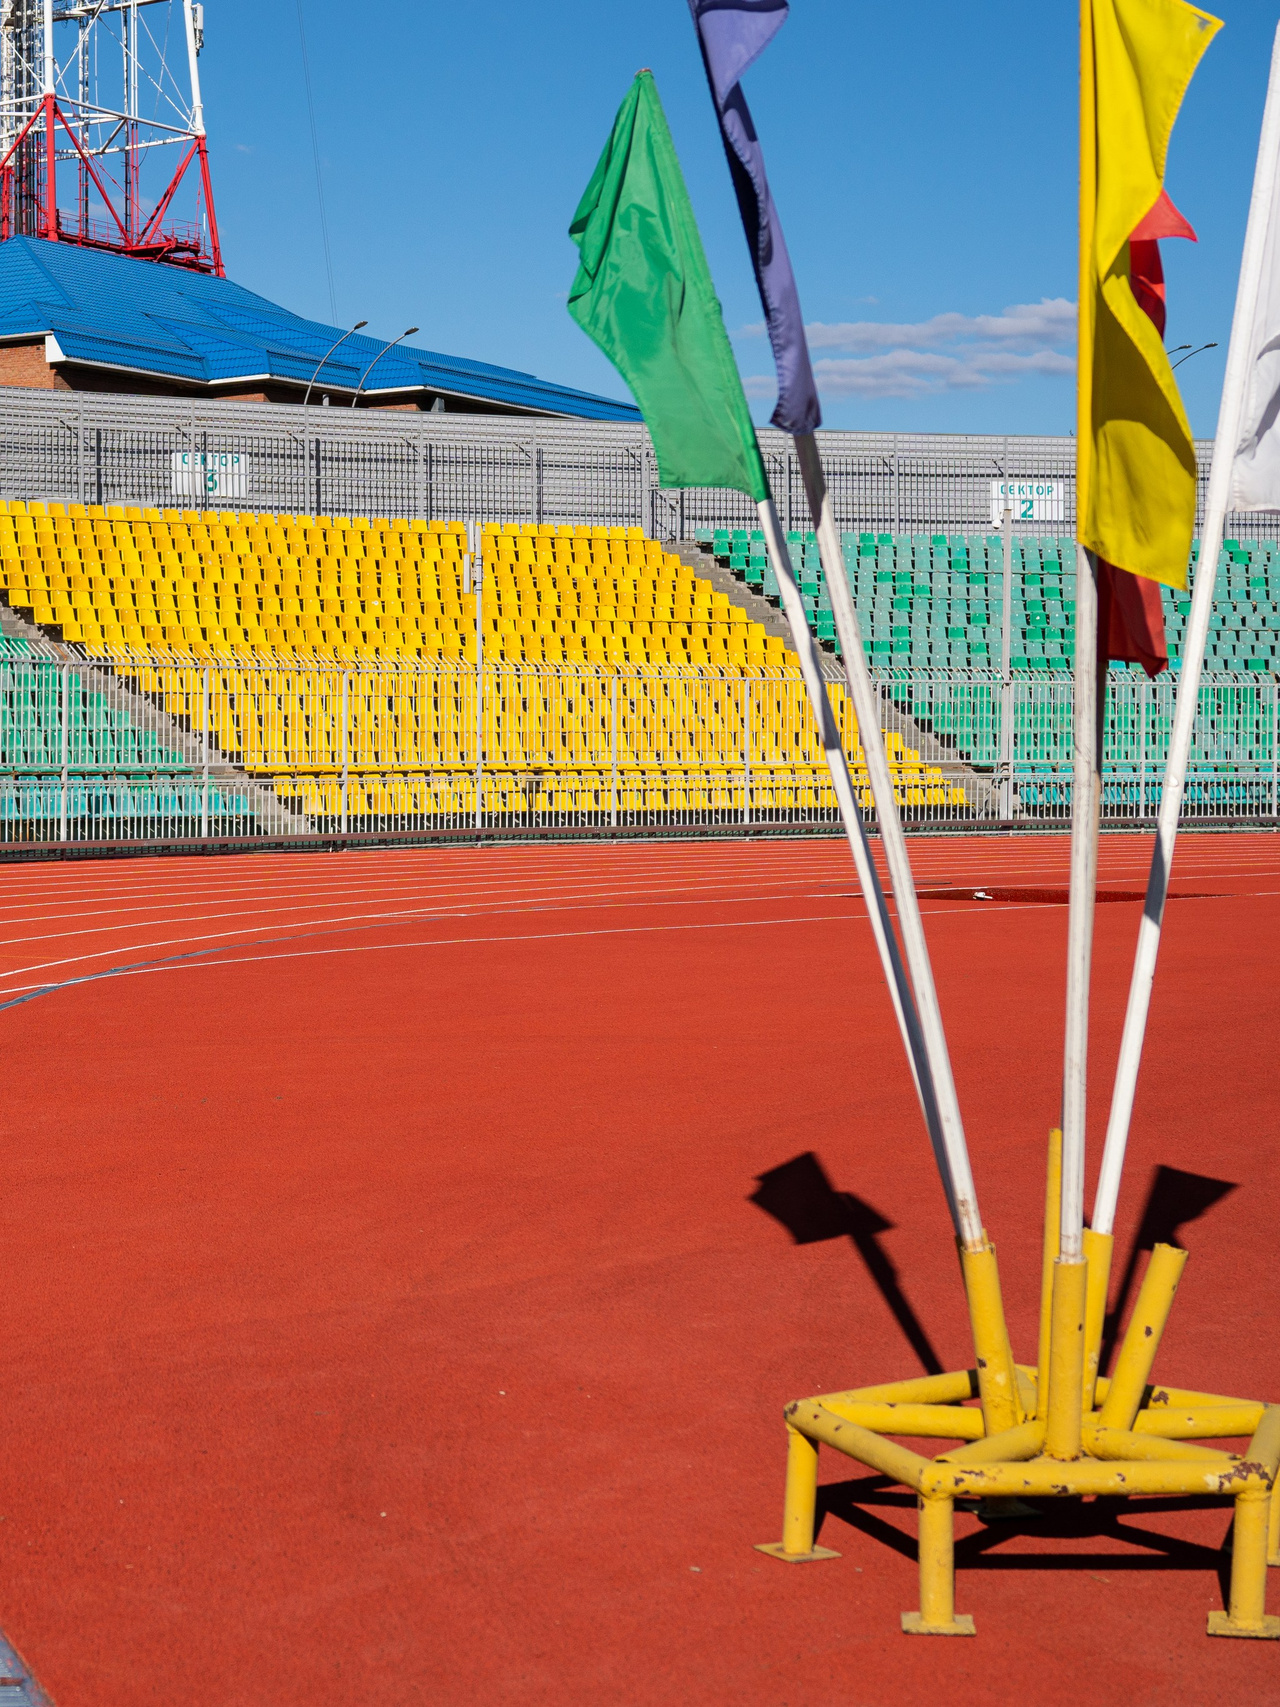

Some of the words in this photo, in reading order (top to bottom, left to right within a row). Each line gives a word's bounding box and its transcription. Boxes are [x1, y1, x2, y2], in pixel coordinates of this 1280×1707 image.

[204, 469, 218, 492] 3
[1000, 484, 1054, 496] СЕКТОР
[1021, 499, 1034, 518] 2
